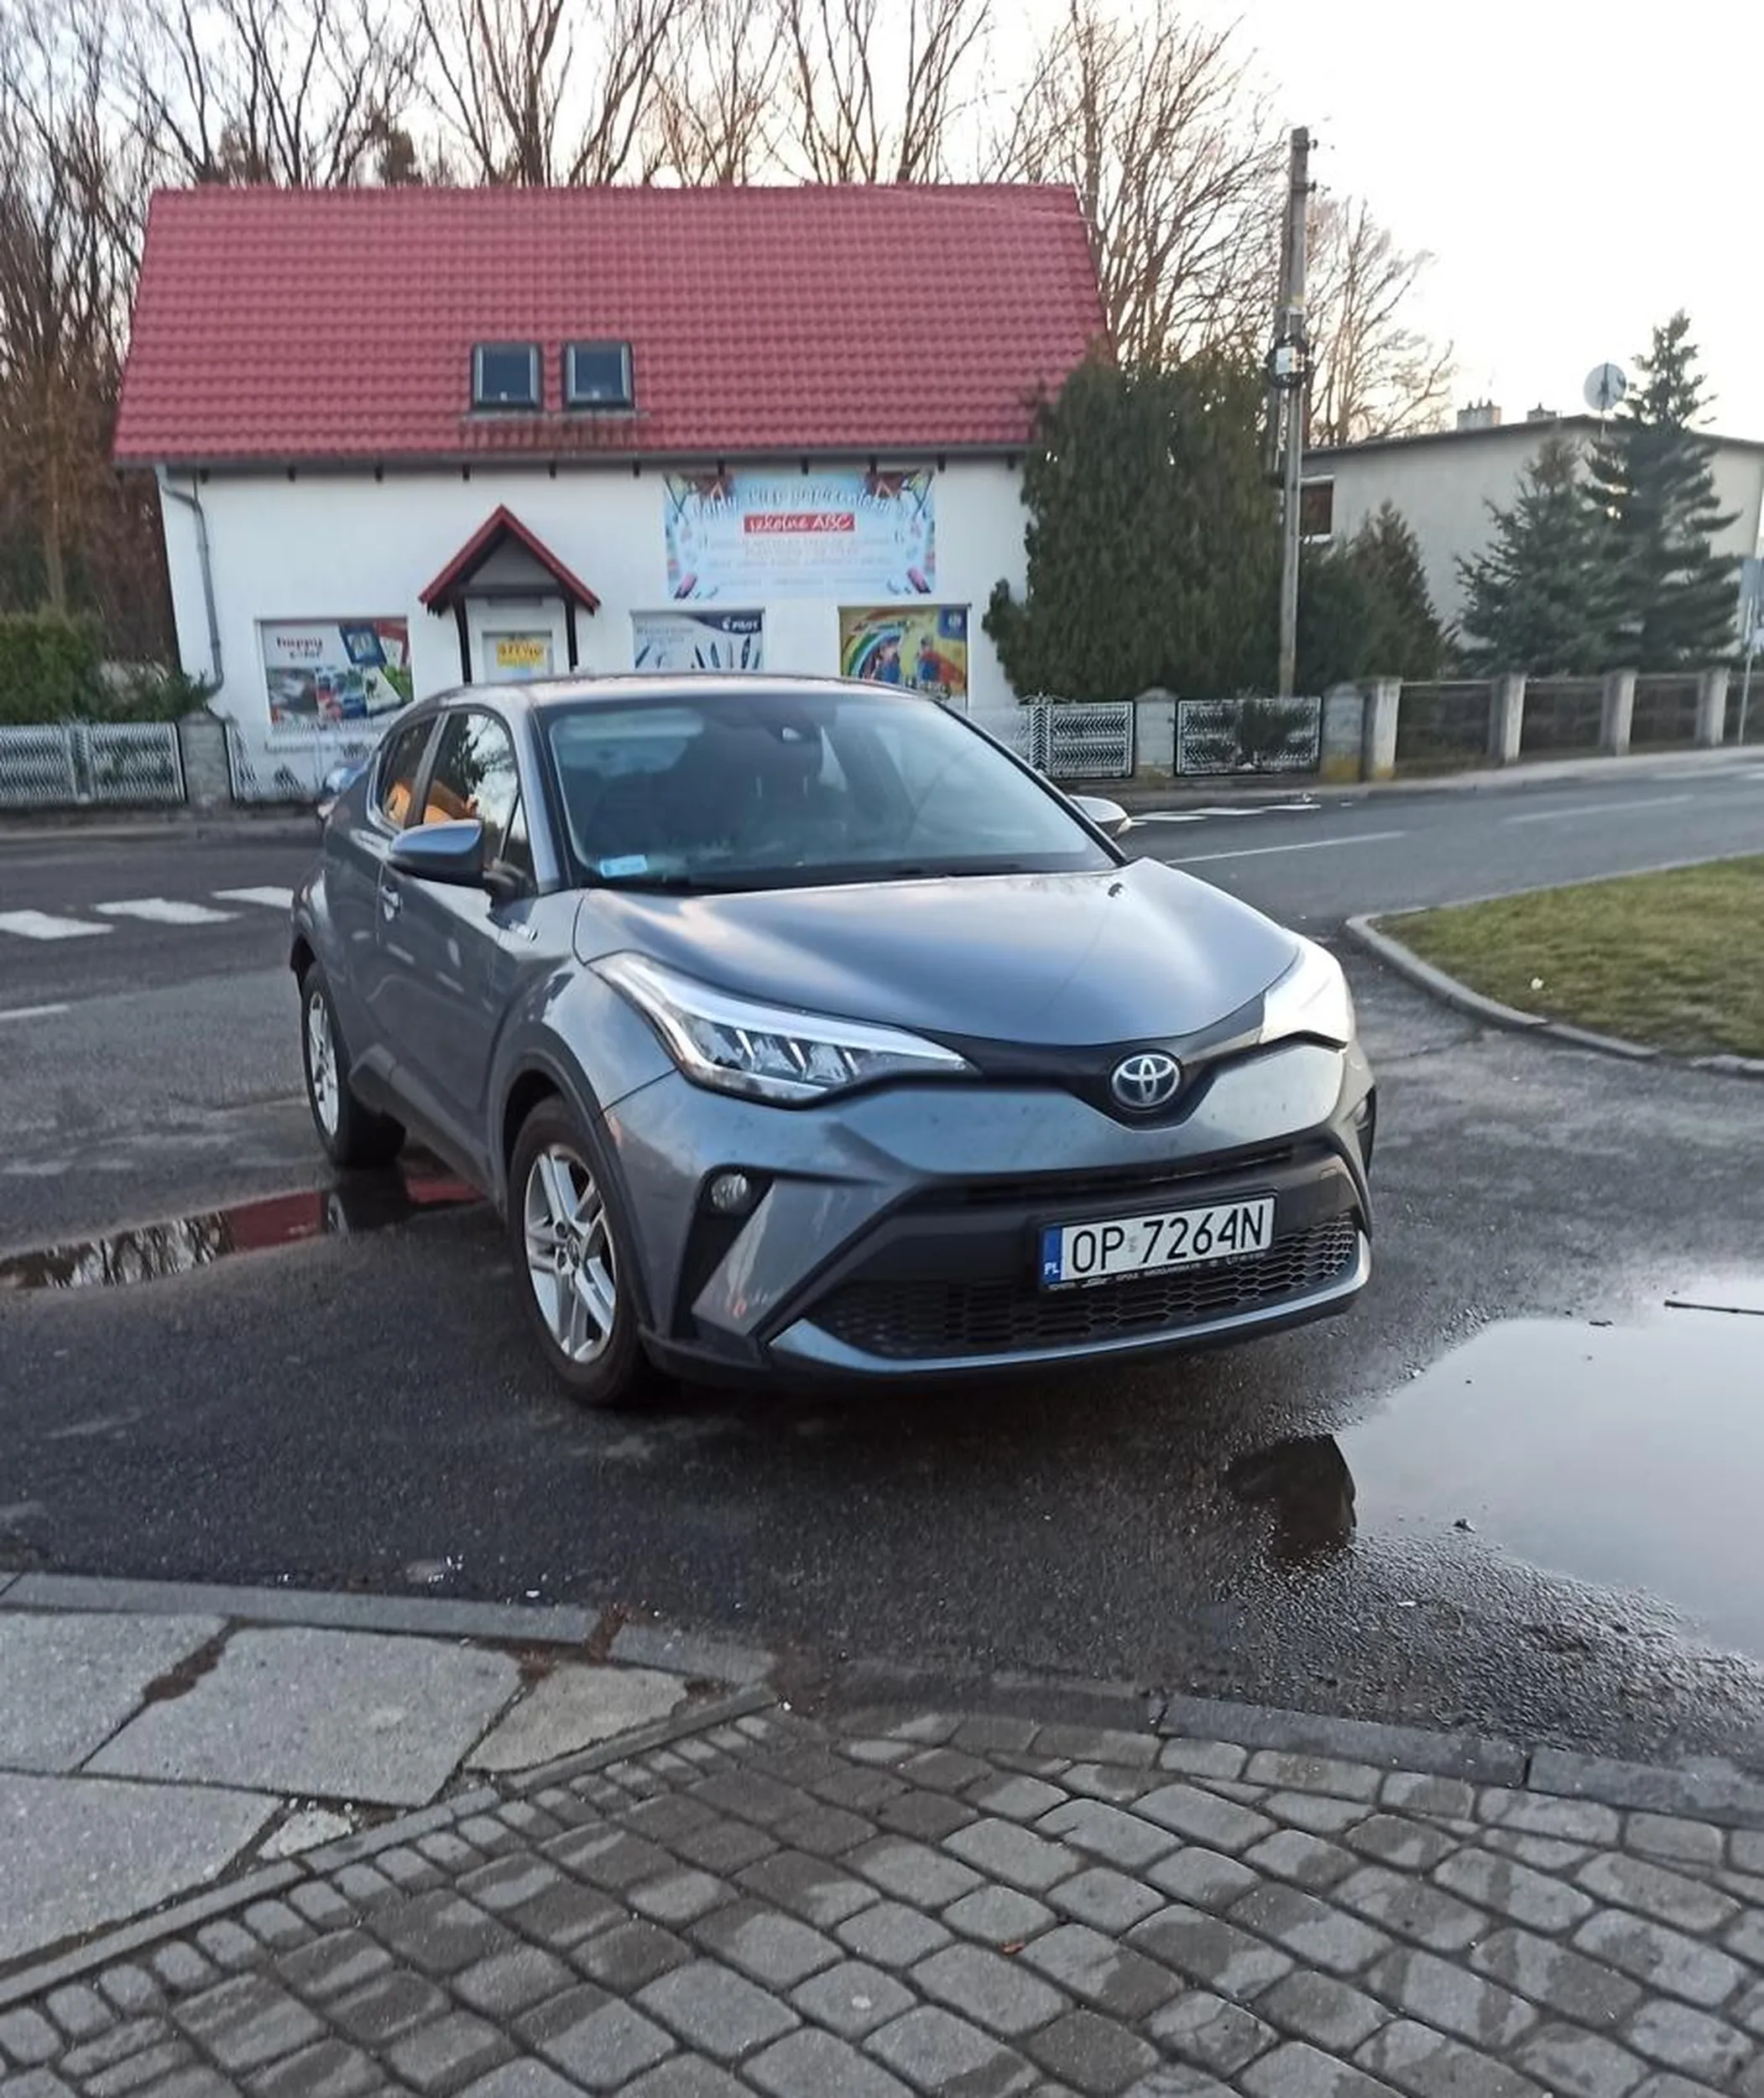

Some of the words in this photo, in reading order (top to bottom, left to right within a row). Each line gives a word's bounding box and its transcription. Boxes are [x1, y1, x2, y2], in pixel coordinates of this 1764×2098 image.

[1072, 1226, 1125, 1273] OP
[1140, 1204, 1264, 1264] 7264N
[1044, 1261, 1060, 1276] PL
